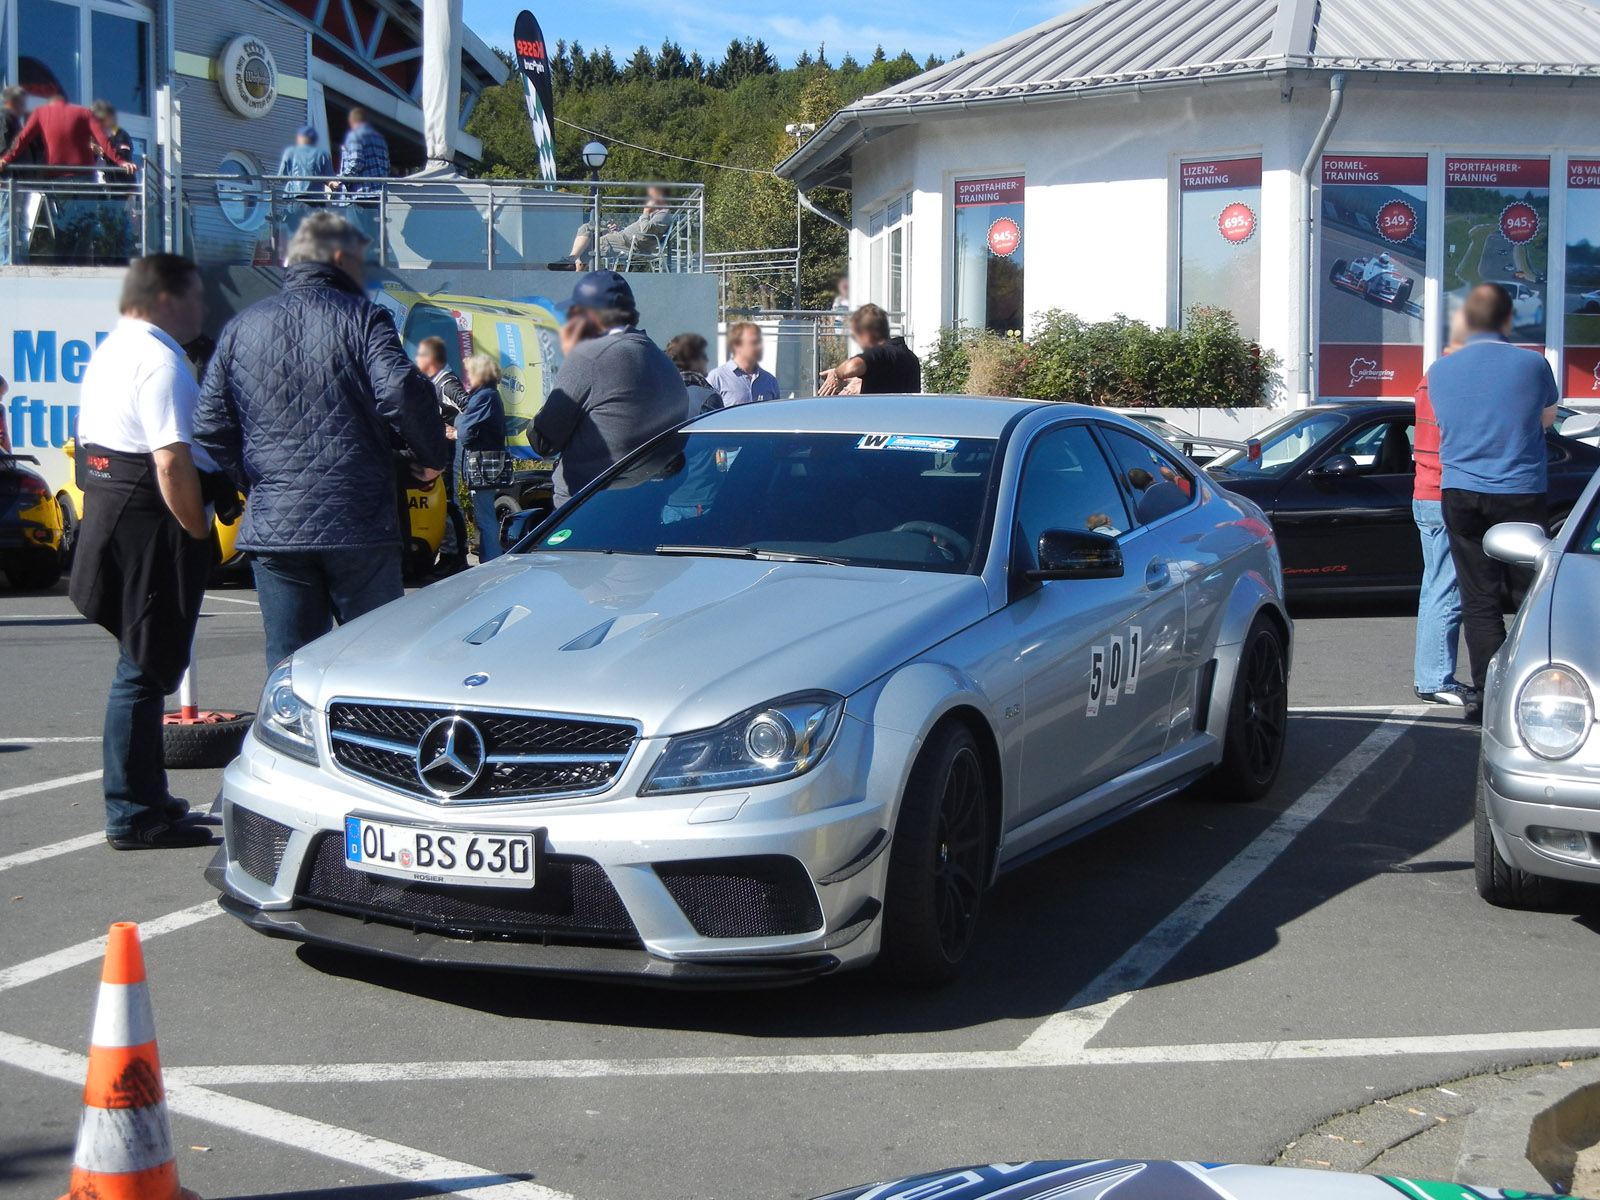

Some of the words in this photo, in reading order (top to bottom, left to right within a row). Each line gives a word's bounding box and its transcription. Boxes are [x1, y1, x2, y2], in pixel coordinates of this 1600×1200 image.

[1183, 165, 1218, 176] LIZENZ-
[1324, 161, 1368, 170] FORMEL-
[1448, 162, 1521, 173] SPORTFAHRER-
[1570, 166, 1584, 175] V8
[1184, 174, 1229, 186] TRAINING
[1325, 171, 1379, 181] TRAININGS
[1448, 173, 1497, 183] TRAINING
[959, 181, 1020, 194] SPORTFAHRER-
[960, 192, 1000, 203] TRAINING
[13, 330, 109, 384] Me
[863, 435, 889, 447] W
[1321, 565, 1348, 573] GTS
[352, 844, 358, 854] D
[363, 825, 396, 863] OL
[415, 833, 457, 870] BS
[465, 837, 530, 874] 630
[413, 873, 445, 883] ROSIER
